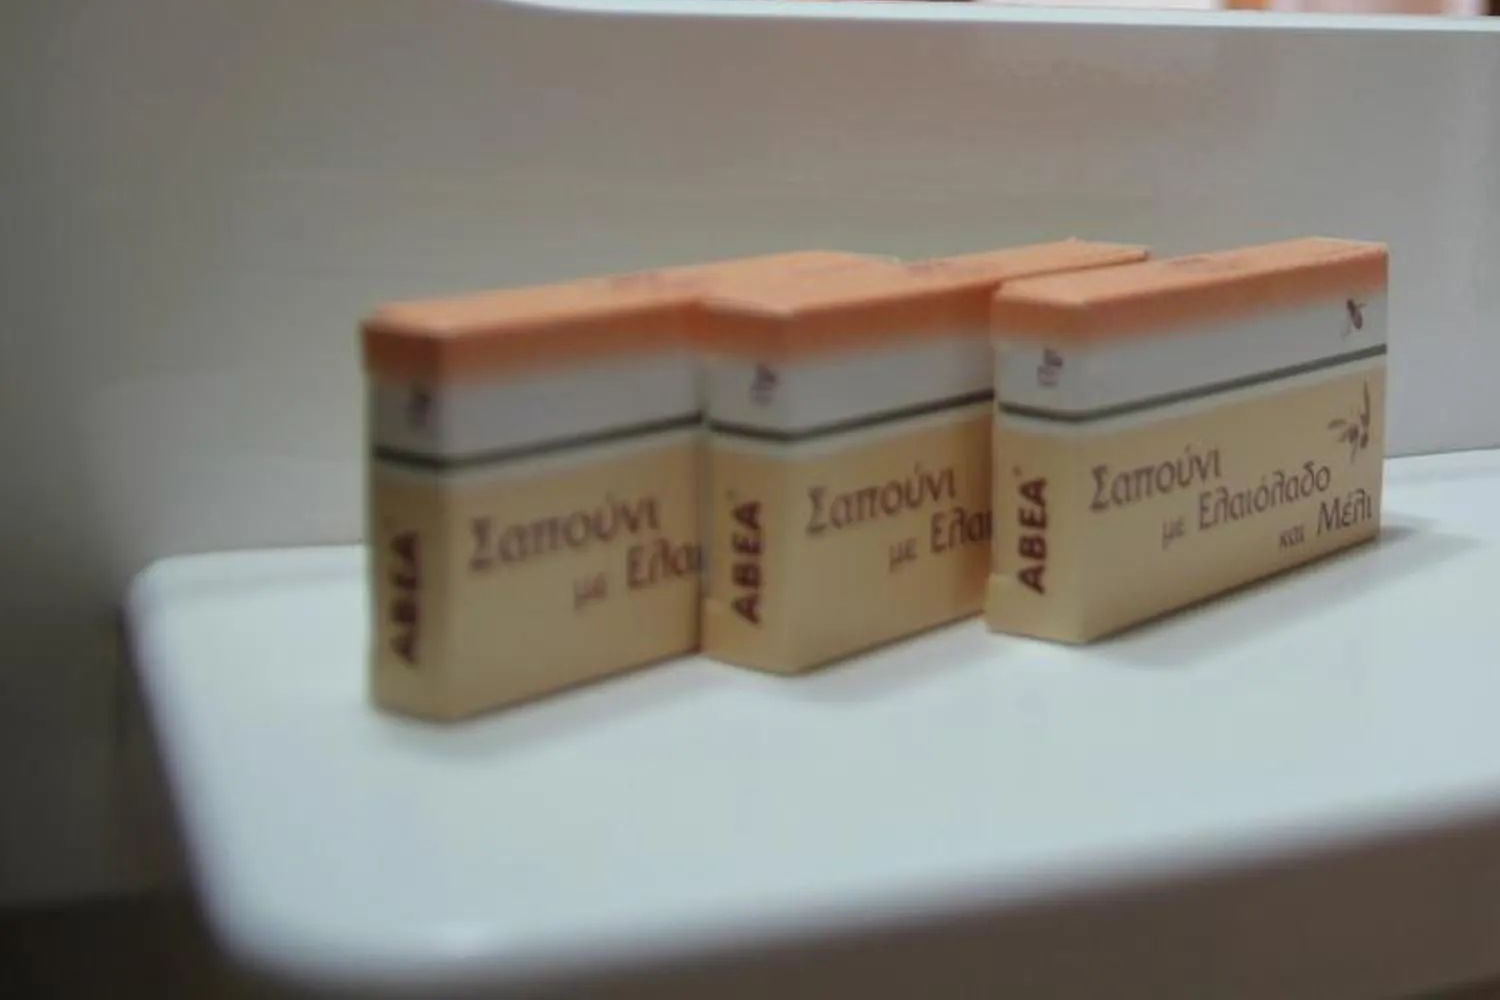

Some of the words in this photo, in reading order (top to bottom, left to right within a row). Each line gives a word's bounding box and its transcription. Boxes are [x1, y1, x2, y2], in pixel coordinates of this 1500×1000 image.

[806, 464, 956, 535] Σαπούνι
[1090, 444, 1221, 512] Σαπούνι
[1162, 518, 1185, 549] με
[1198, 459, 1331, 531] Ελαιόλαδο
[468, 497, 662, 572] Σαπούνι
[930, 505, 992, 554] Ελαι
[1279, 524, 1305, 550] και
[1316, 488, 1373, 537] Μέλι
